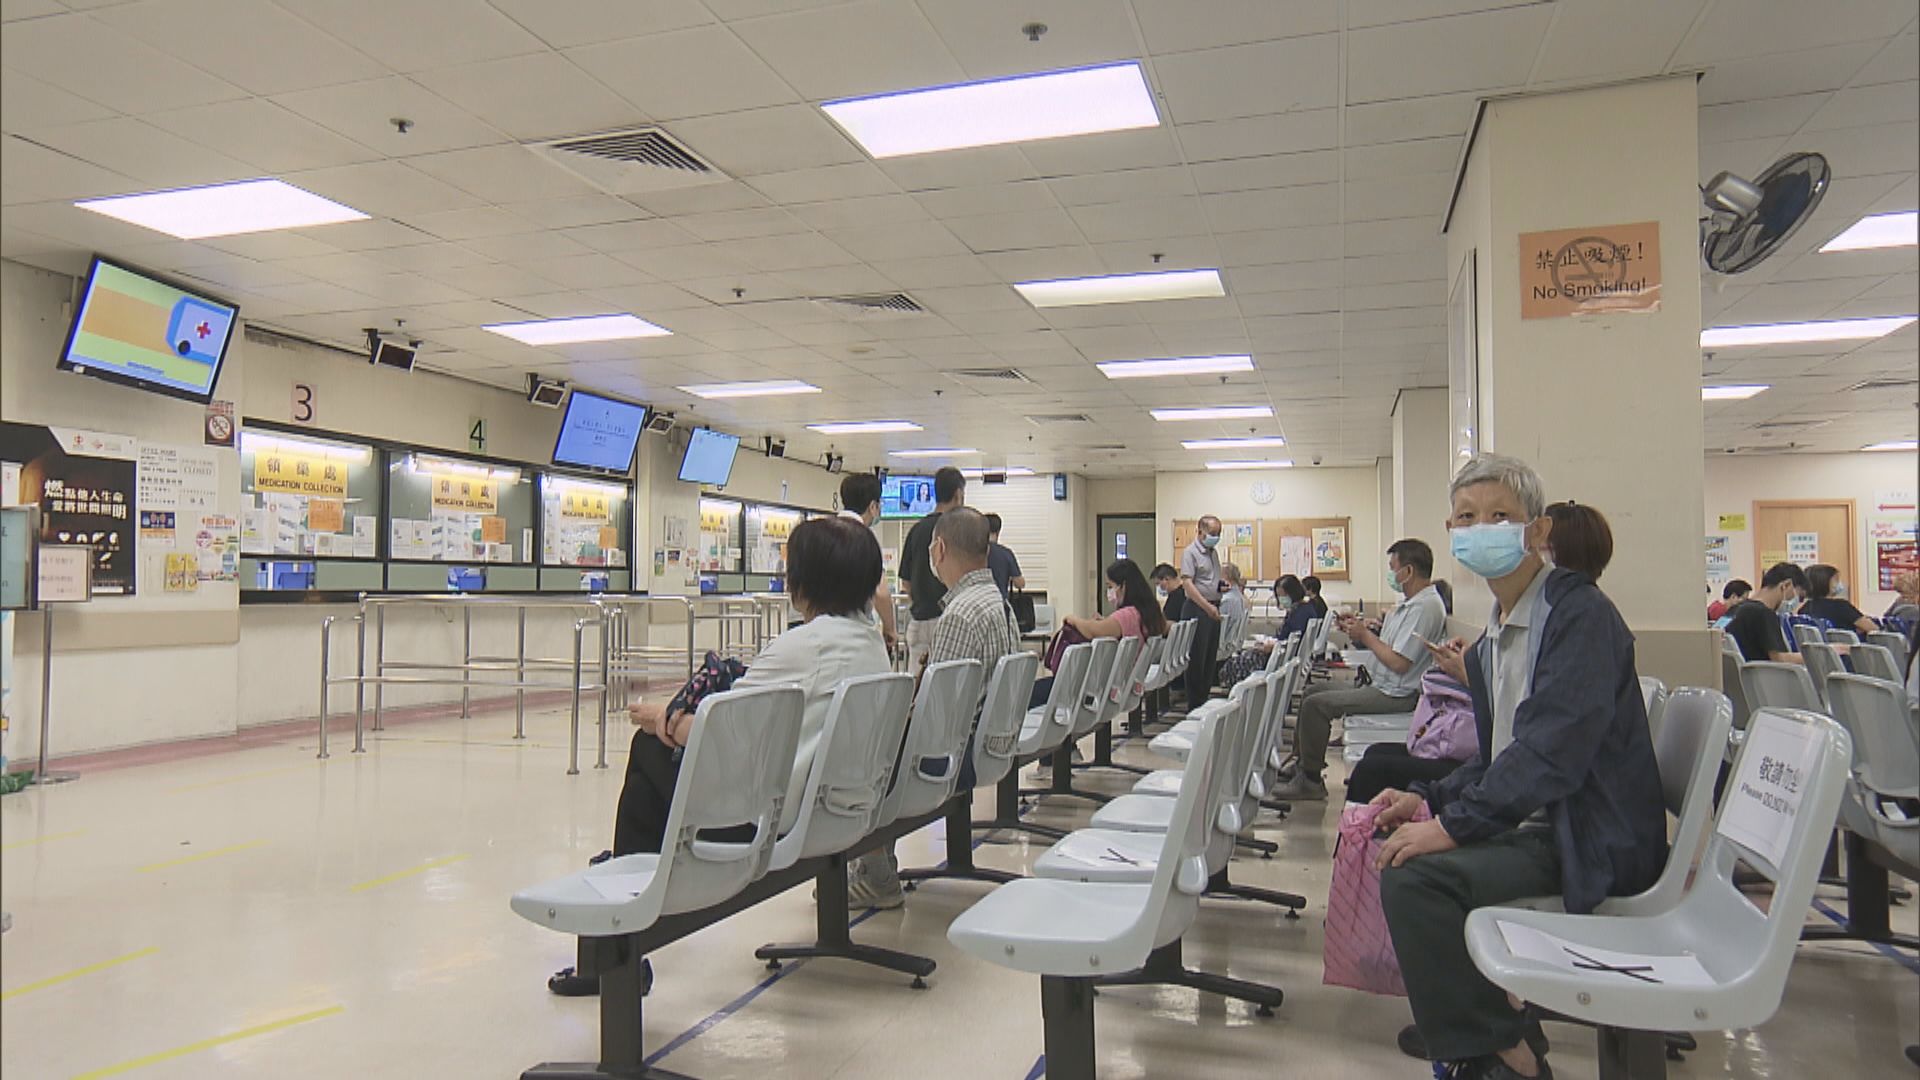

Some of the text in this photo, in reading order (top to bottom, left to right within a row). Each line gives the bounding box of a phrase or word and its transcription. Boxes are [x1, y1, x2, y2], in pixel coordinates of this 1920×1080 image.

[1533, 277, 1647, 299] No Smoking!
[294, 384, 313, 422] 3
[469, 419, 485, 449] 4
[258, 477, 344, 494] MEDICATION COLLECTION
